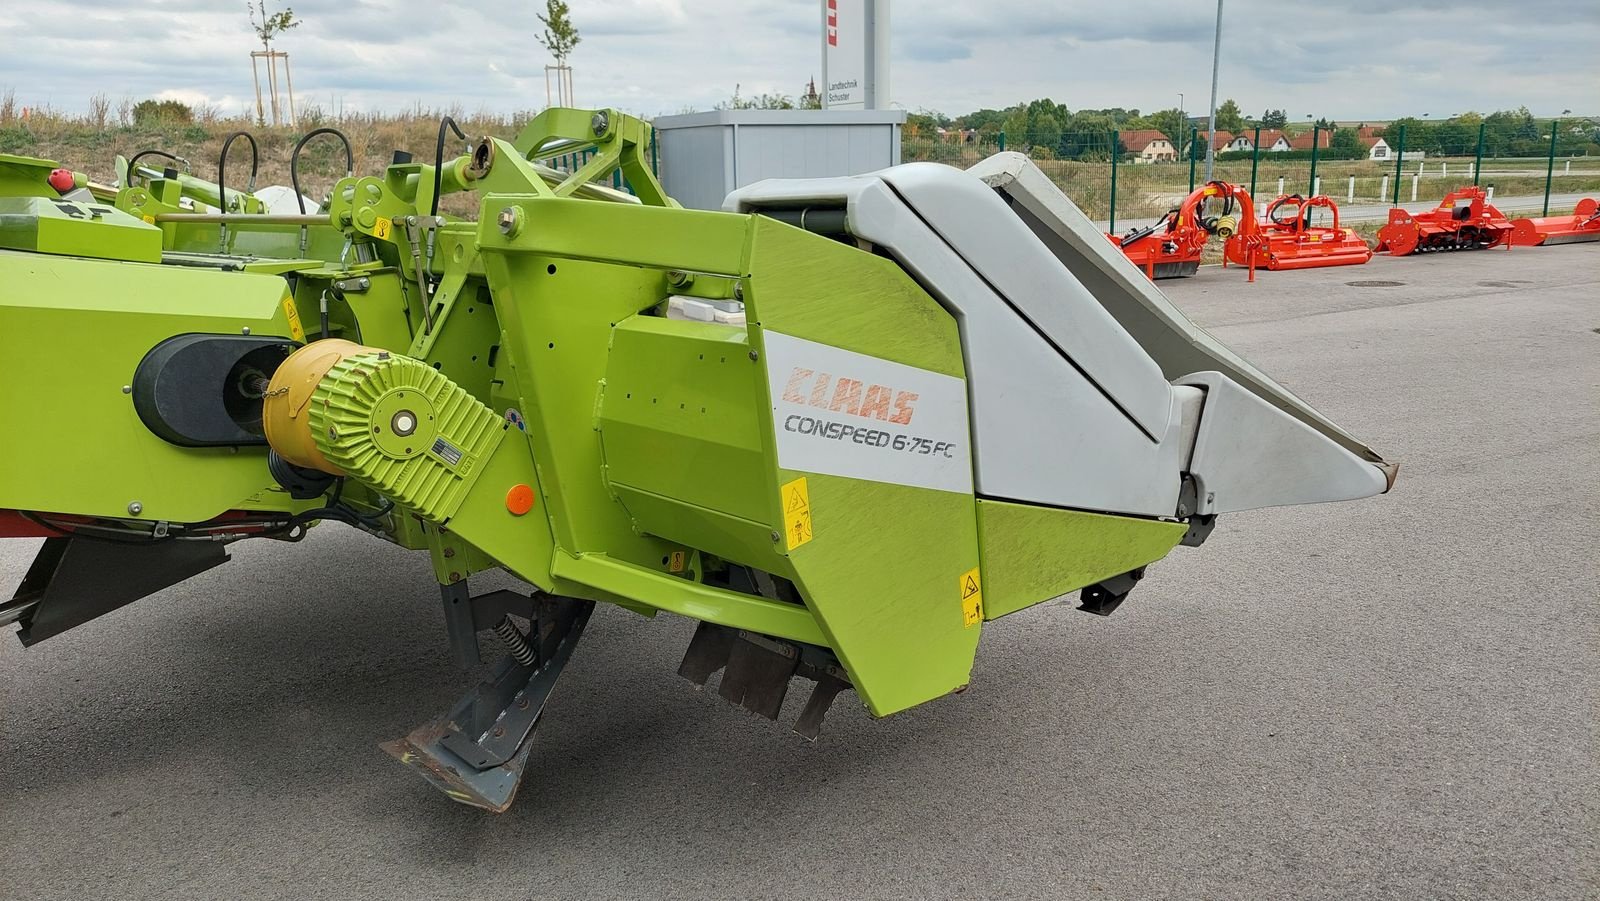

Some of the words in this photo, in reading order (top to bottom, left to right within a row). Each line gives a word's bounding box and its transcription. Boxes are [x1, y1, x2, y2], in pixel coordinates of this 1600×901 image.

[829, 79, 857, 90] Landtechnik
[829, 93, 849, 102] Schuster
[782, 367, 919, 425] CLAAS
[784, 414, 891, 448] CONSPEED
